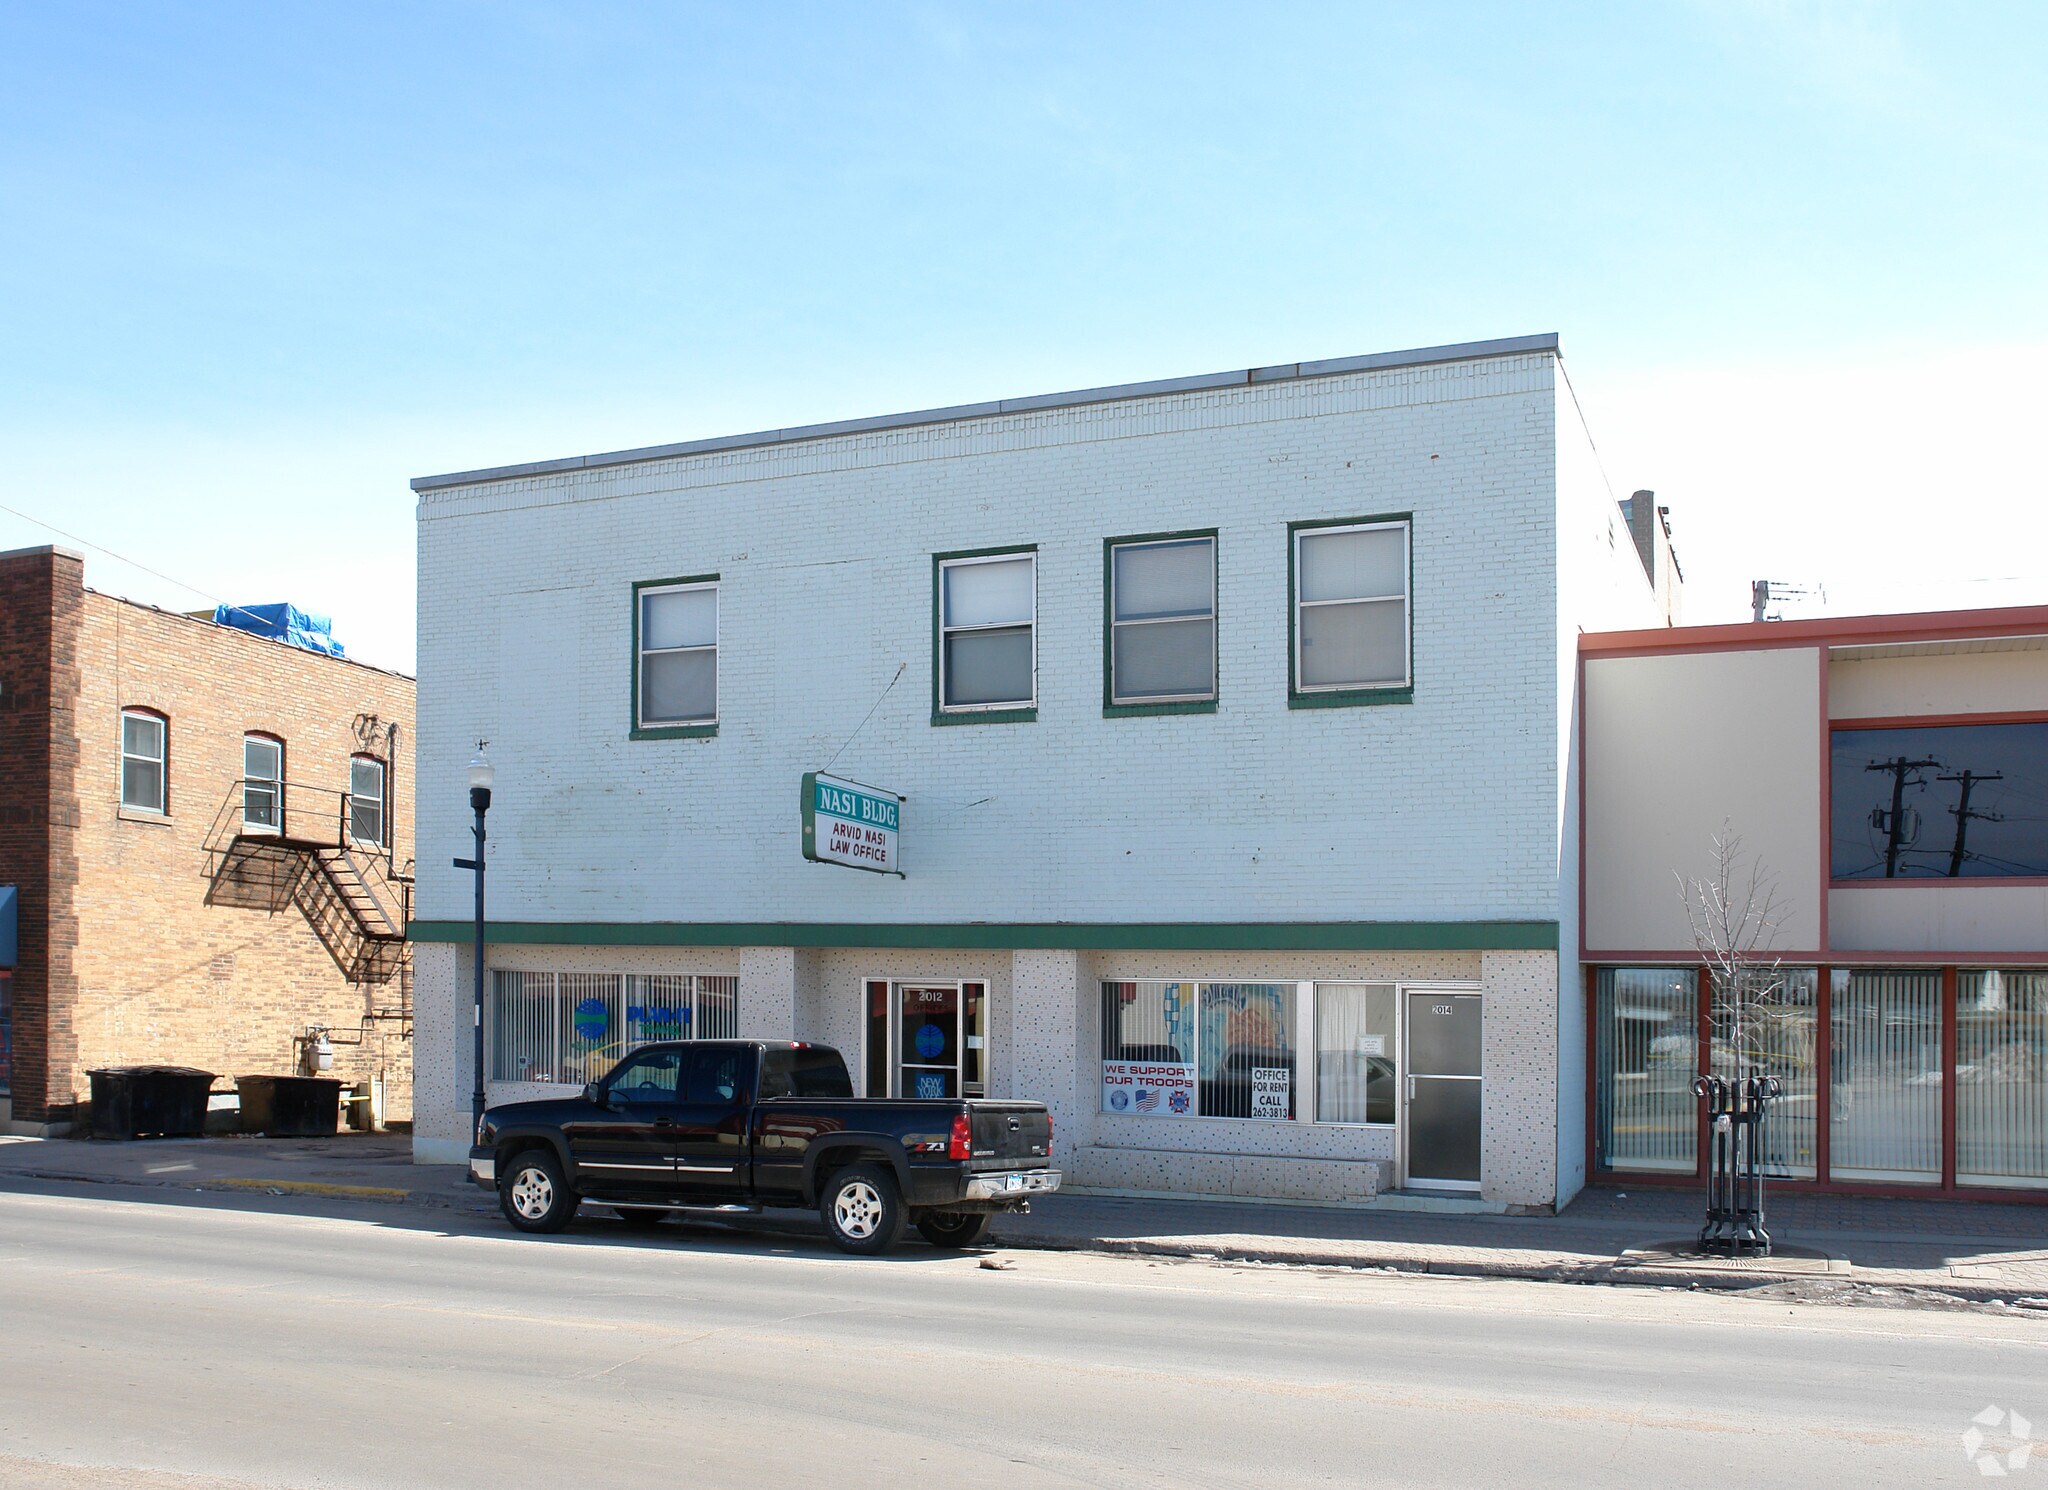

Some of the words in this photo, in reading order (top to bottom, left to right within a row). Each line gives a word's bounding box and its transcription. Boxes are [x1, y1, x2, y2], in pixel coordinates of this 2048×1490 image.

[820, 787, 856, 816] NASI
[862, 798, 896, 827] BLDG.
[833, 822, 862, 840] ARVID
[865, 830, 886, 846] NASI
[830, 838, 850, 854] LAW
[853, 843, 886, 862] OFFICE
[918, 992, 943, 1002] 2012
[1432, 1005, 1452, 1014] 2014
[639, 1024, 681, 1035] TRAVEL
[1105, 1065, 1125, 1074] WE
[1130, 1066, 1194, 1077] SUPPORT
[1254, 1070, 1287, 1080] OFFICE
[920, 1077, 941, 1089] NEW
[1105, 1076, 1133, 1085] OUR
[1137, 1077, 1194, 1088] TROOPS
[1253, 1082, 1268, 1092] FOR
[1269, 1082, 1288, 1093] RENT
[917, 1085, 943, 1097] YORK
[1259, 1095, 1282, 1106] CALL
[1252, 1107, 1288, 1118] 262-3813
[914, 1142, 945, 1152] Z71
